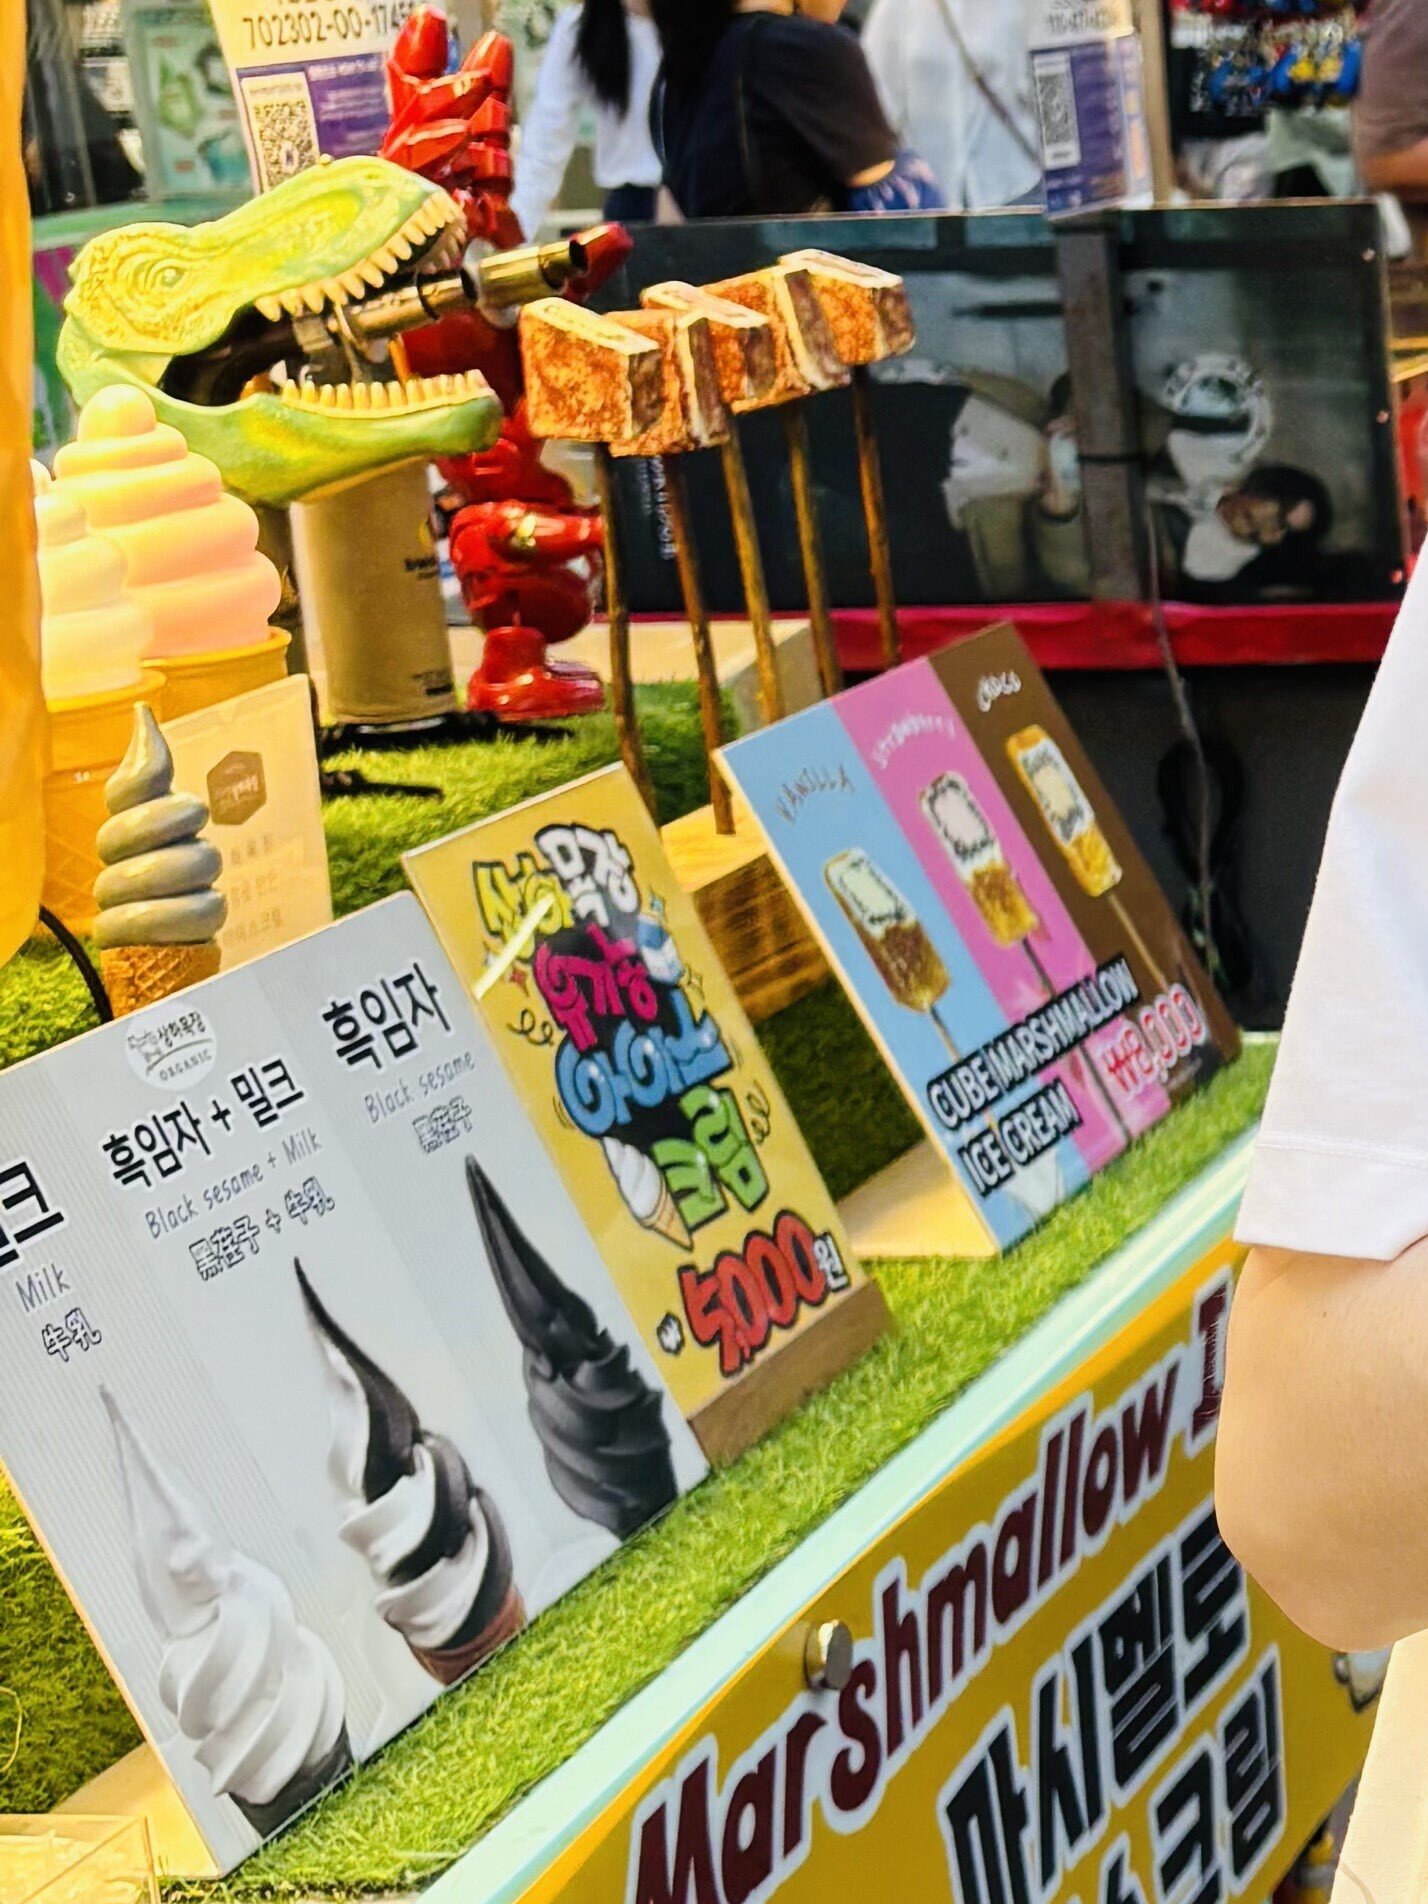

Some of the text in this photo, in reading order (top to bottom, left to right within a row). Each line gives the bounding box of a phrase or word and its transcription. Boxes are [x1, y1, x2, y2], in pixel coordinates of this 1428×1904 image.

[322, 962, 453, 1073] 흑임자
[928, 957, 1139, 1128] CUBE MARSHMALLOW
[102, 1101, 212, 1188] 흑임자
[230, 1059, 305, 1129] 밀크
[365, 1050, 477, 1124] Black sesame
[961, 1082, 1082, 1196] ICE CREAM
[0, 1162, 65, 1268] 크
[145, 1198, 200, 1240] Black
[203, 1163, 264, 1210] sesame
[281, 1127, 324, 1165] Milk
[15, 1263, 72, 1314] Milk
[41, 1306, 103, 1363] 牛乳
